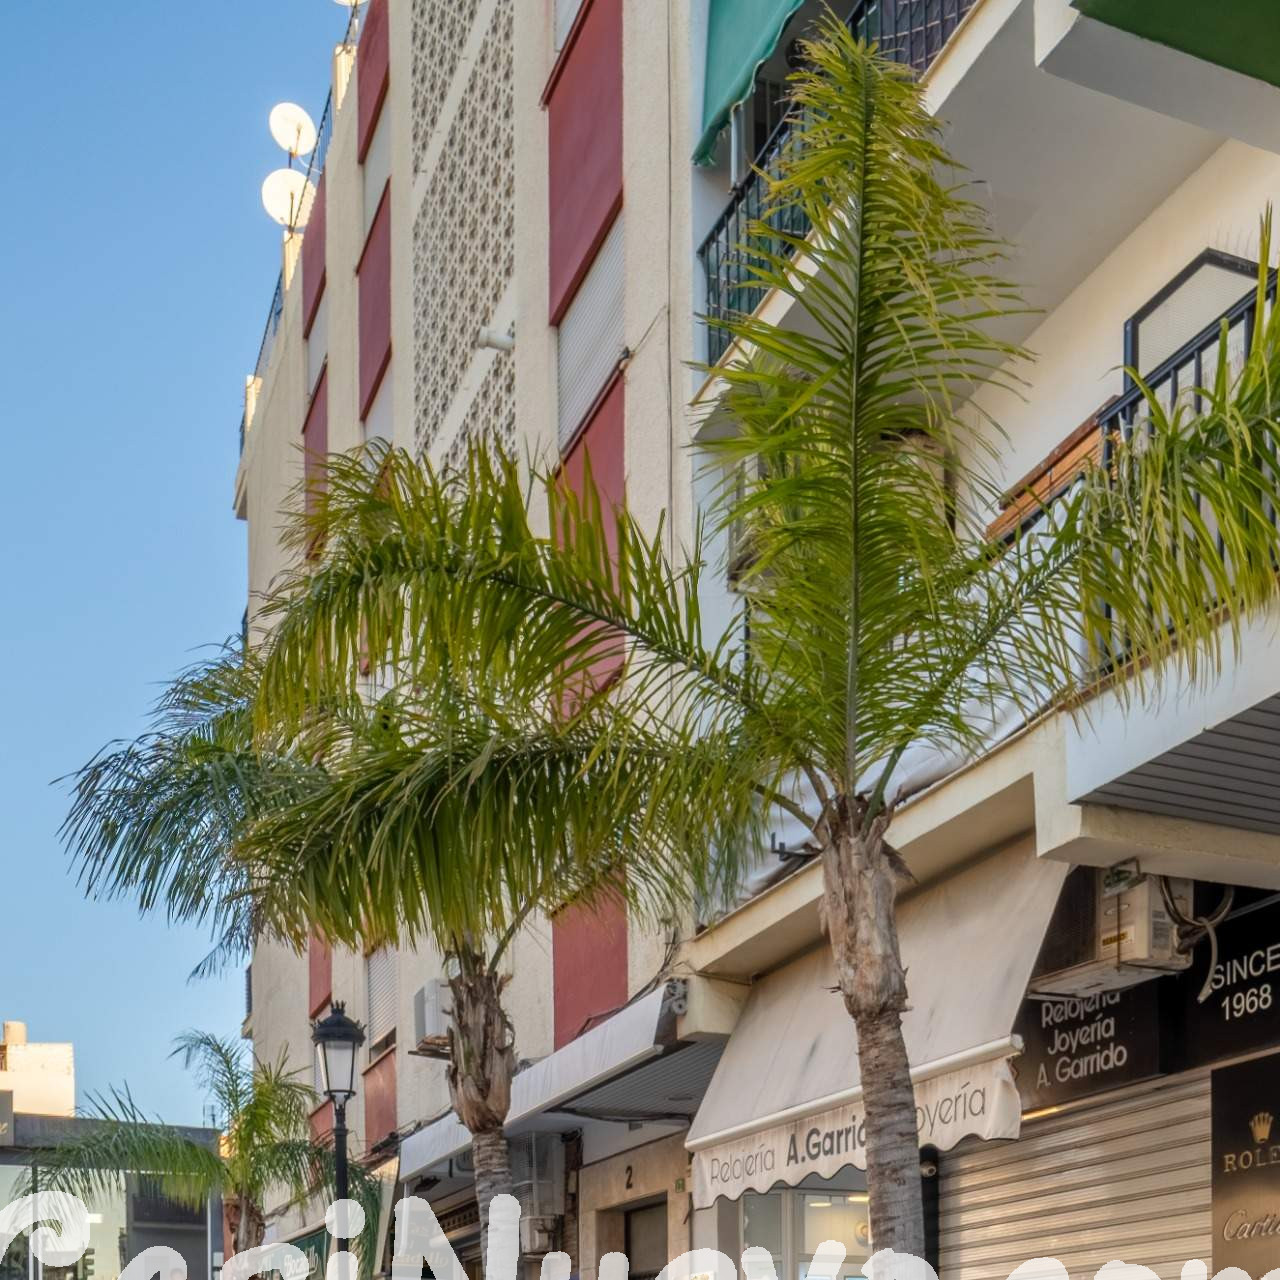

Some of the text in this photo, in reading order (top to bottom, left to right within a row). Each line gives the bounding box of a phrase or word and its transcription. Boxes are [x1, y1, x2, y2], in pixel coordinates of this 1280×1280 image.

[1221, 984, 1273, 1021] 1968
[1047, 1010, 1115, 1056] Joyería
[1055, 1044, 1128, 1083] Garrido
[710, 1082, 986, 1186] Relojería A.Garri oyería
[625, 1165, 633, 1189] 2
